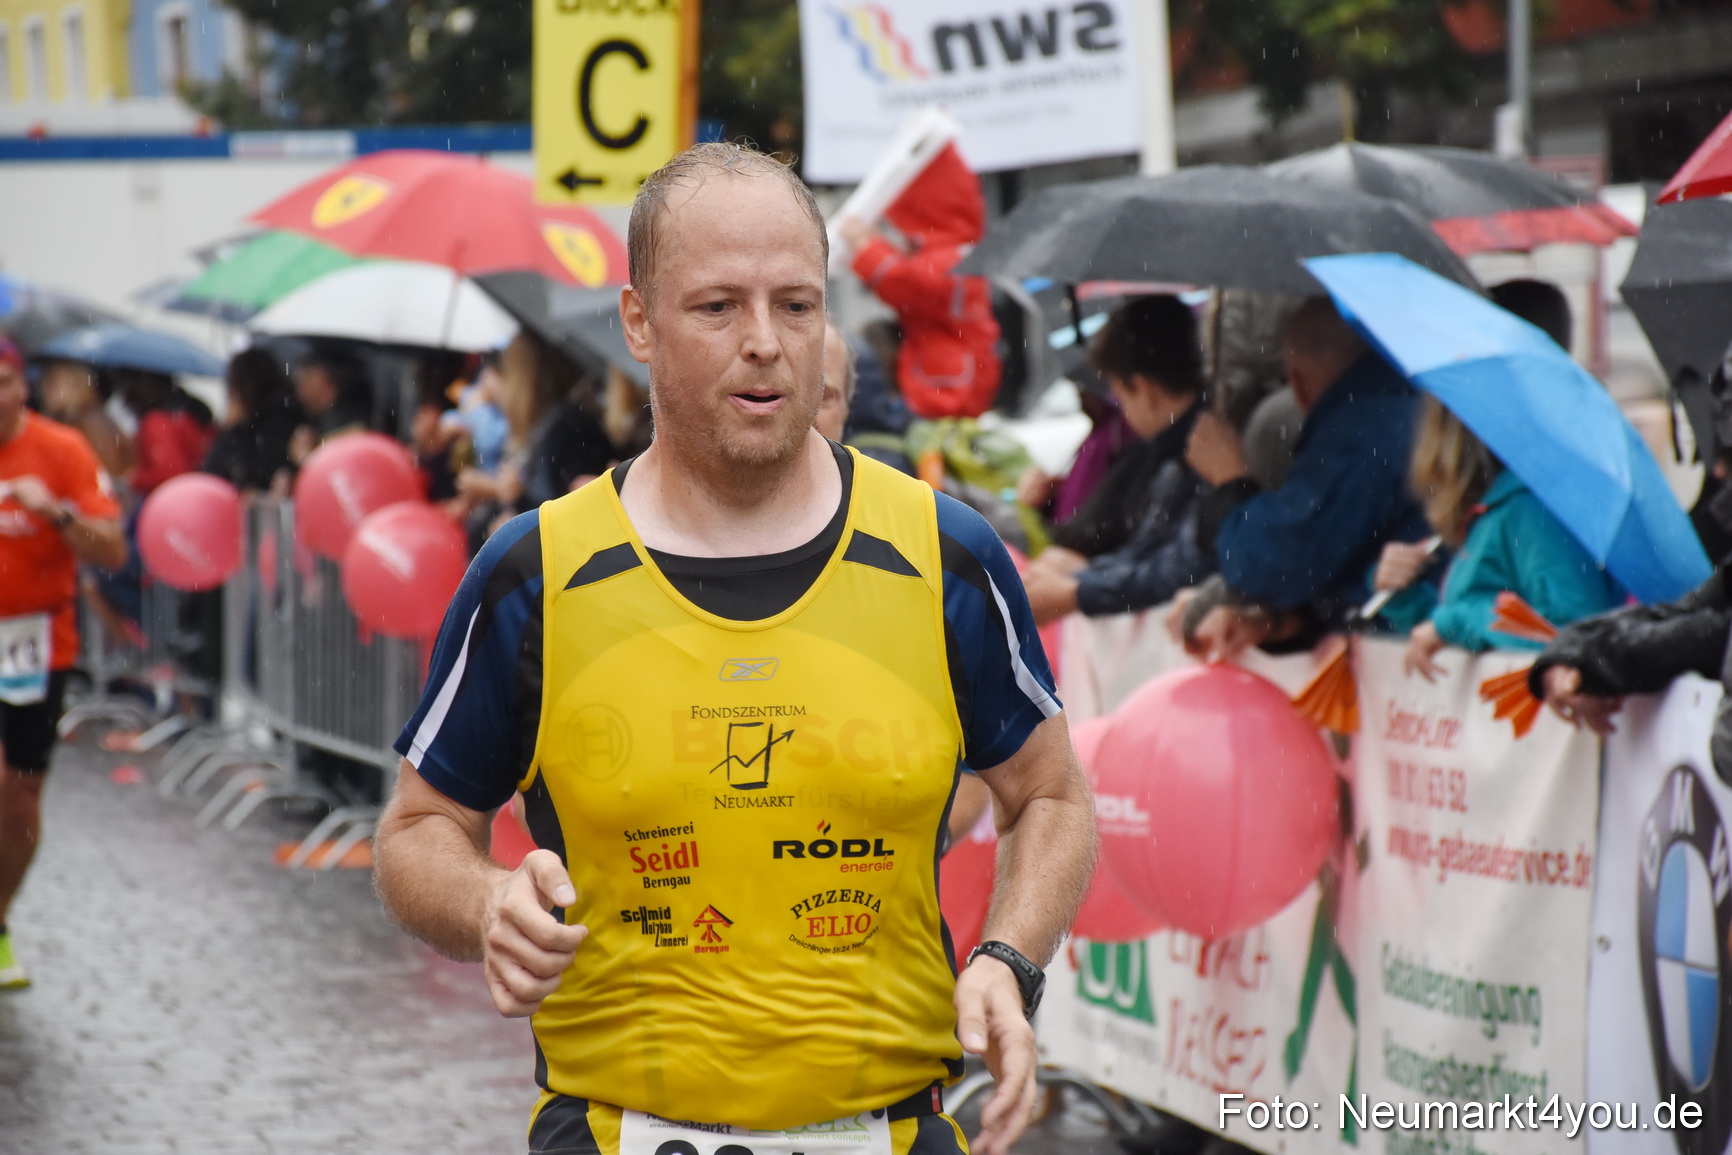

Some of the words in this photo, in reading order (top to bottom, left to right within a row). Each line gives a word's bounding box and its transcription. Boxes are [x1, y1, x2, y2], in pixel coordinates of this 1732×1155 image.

[580, 39, 649, 149] C
[690, 705, 806, 719] FONDSZENTRUM
[714, 795, 795, 810] NEUMARKT
[624, 821, 694, 842] Schreinerei
[629, 841, 700, 873] Seidl
[840, 857, 894, 873] energie
[643, 876, 691, 889] Berngau
[790, 889, 881, 920] PIZZERIA
[806, 913, 872, 938] ELIO
[694, 945, 730, 954] Berngau
